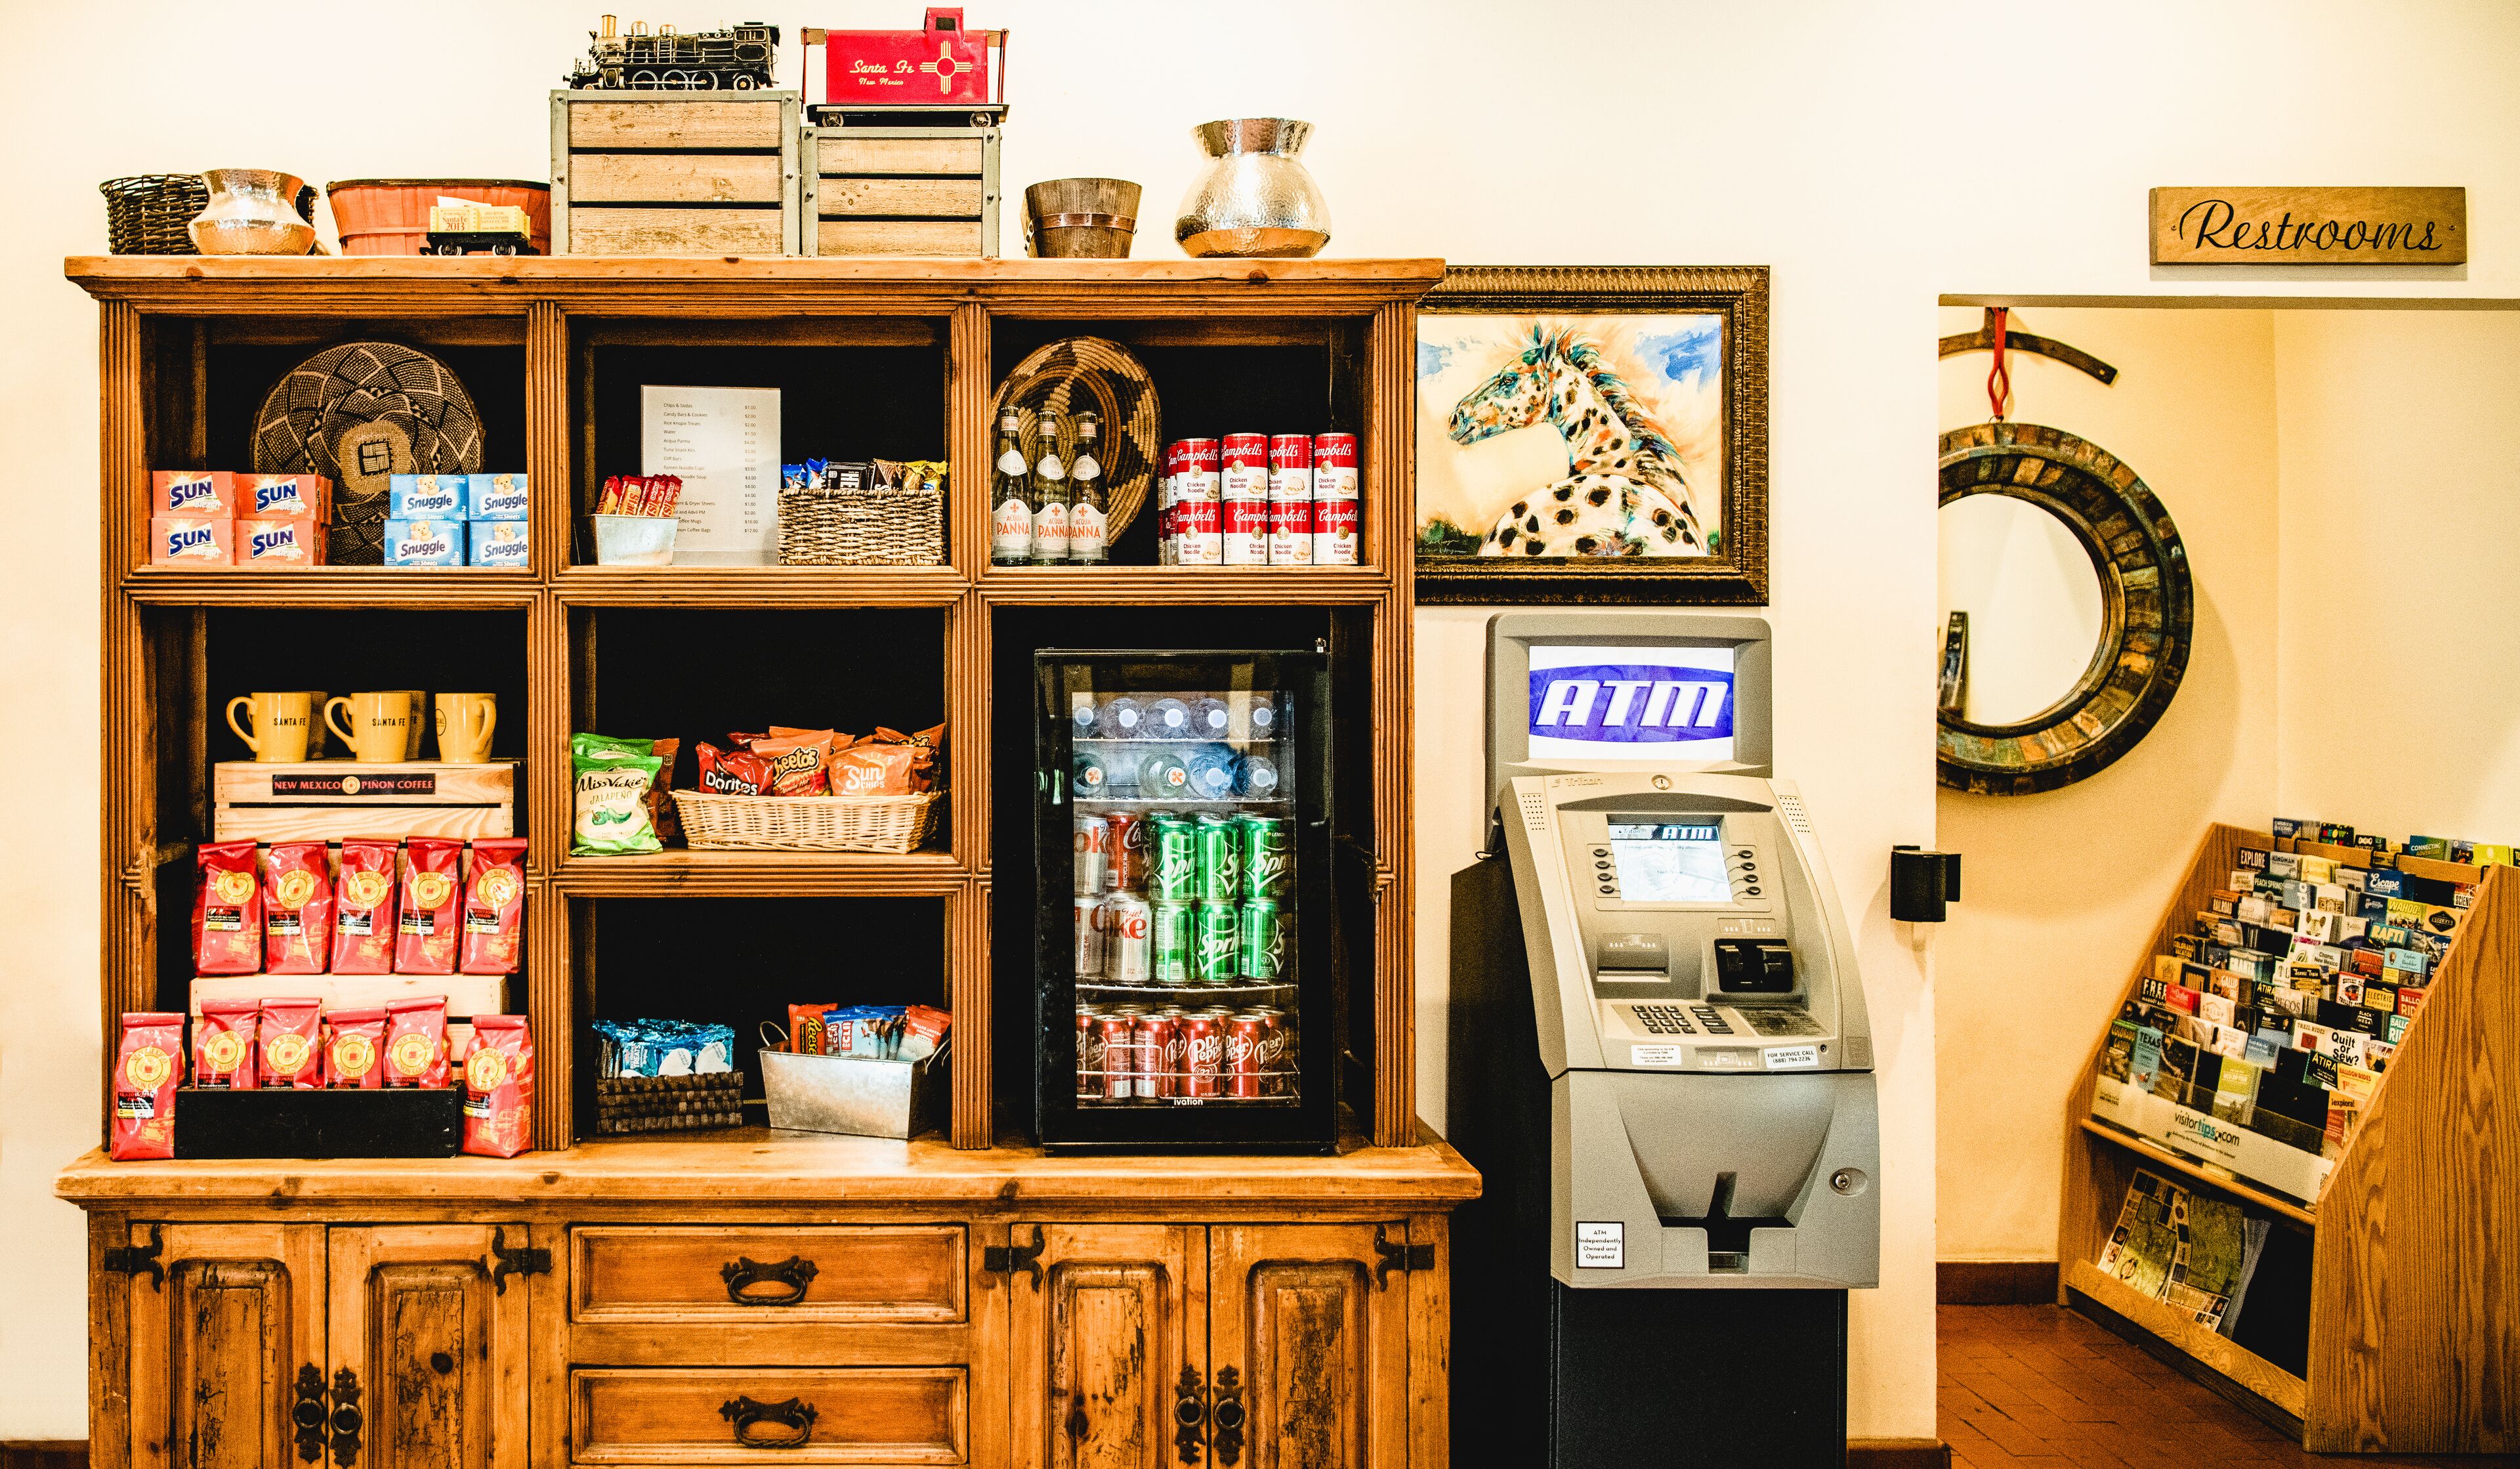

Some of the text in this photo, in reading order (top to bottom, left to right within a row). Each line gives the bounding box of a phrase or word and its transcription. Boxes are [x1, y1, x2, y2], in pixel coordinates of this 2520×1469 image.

[849, 60, 915, 74] Santa Fe
[446, 222, 465, 231] 2013
[2179, 200, 2443, 251] Restrooms
[1177, 448, 1218, 463] Campbell's
[169, 480, 213, 511] SUN
[255, 484, 297, 513] SUN
[407, 494, 452, 511] Snuggle
[484, 493, 528, 511] Snuggle
[997, 522, 1030, 535] PANNA
[1038, 525, 1069, 538] PANNA
[168, 528, 212, 558] SUN
[251, 530, 295, 559] SUN
[400, 540, 446, 557] Snuggle
[484, 541, 528, 558] Snuggle
[1532, 679, 1729, 728] ATM
[274, 717, 297, 726] SANTA
[372, 718, 406, 727] SANTA FE
[773, 748, 820, 785] heetos
[361, 778, 395, 789] PIÑON
[705, 770, 759, 796] Doritos
[845, 764, 886, 790] Sun
[1565, 777, 1603, 787] Triton
[577, 776, 608, 794] Miss
[1661, 826, 1713, 840] ATM
[1123, 851, 1128, 861] ME
[2240, 849, 2265, 868] EXPLORE
[2272, 855, 2296, 864] KINGMAN
[2254, 878, 2284, 889] PEACH SPRINGS
[2369, 873, 2401, 895] Escape
[2389, 901, 2422, 916] WAHOO!
[1084, 933, 1089, 945] ME
[2324, 958, 2338, 968] Mexico
[2258, 983, 2276, 996] ATIRA
[2367, 990, 2393, 1003] ELECTRIC
[2275, 996, 2301, 1013] PECOS
[2298, 1021, 2326, 1035] TRAIL RIDES
[1205, 1035, 1221, 1050] Dr
[2141, 1031, 2162, 1048] TEXAS
[2332, 1032, 2355, 1048] Quilt
[2312, 1052, 2337, 1073] ATIRA
[2332, 1049, 2359, 1066] Sew?
[2339, 1068, 2371, 1082] BALLOON RIDES
[1173, 1097, 1204, 1106] ivation
